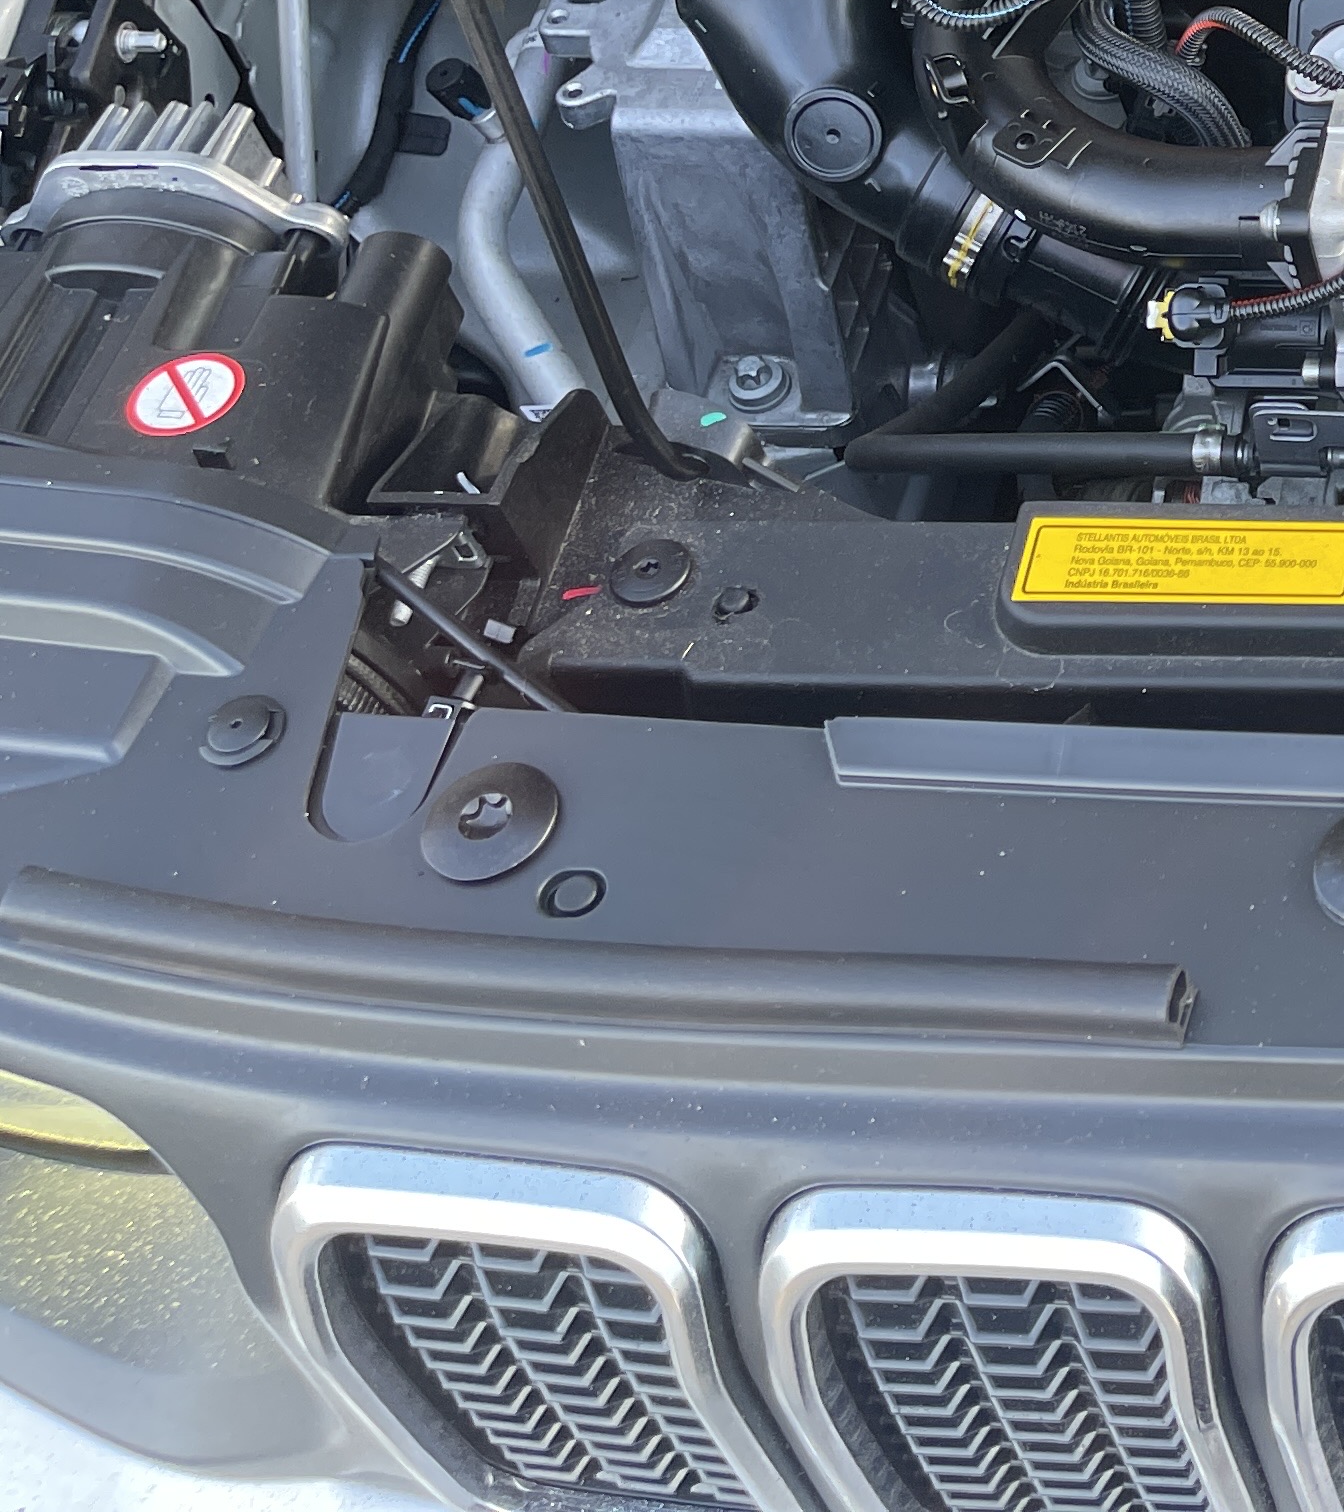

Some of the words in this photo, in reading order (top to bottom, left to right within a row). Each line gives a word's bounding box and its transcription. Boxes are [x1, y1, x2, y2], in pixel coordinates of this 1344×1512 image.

[1076, 532, 1129, 543] STELLANTIS
[1131, 532, 1189, 544] AUTOMÓVEIS
[1191, 535, 1221, 544] BRASIL
[1224, 535, 1247, 544] LTDA
[1073, 544, 1114, 554] Rodovia
[1117, 545, 1154, 554] BR-101
[1163, 545, 1194, 556] Norte,
[1217, 547, 1235, 555] KM
[1238, 547, 1249, 556] 13
[1070, 556, 1095, 565] Nova
[1098, 556, 1134, 567] Goiana,
[1136, 557, 1172, 567] Goiana,
[1174, 557, 1235, 568] Pernambuco,
[1067, 568, 1096, 577] CNPJ
[1064, 579, 1108, 589] Indústria
[1111, 579, 1158, 589] Brasileira
